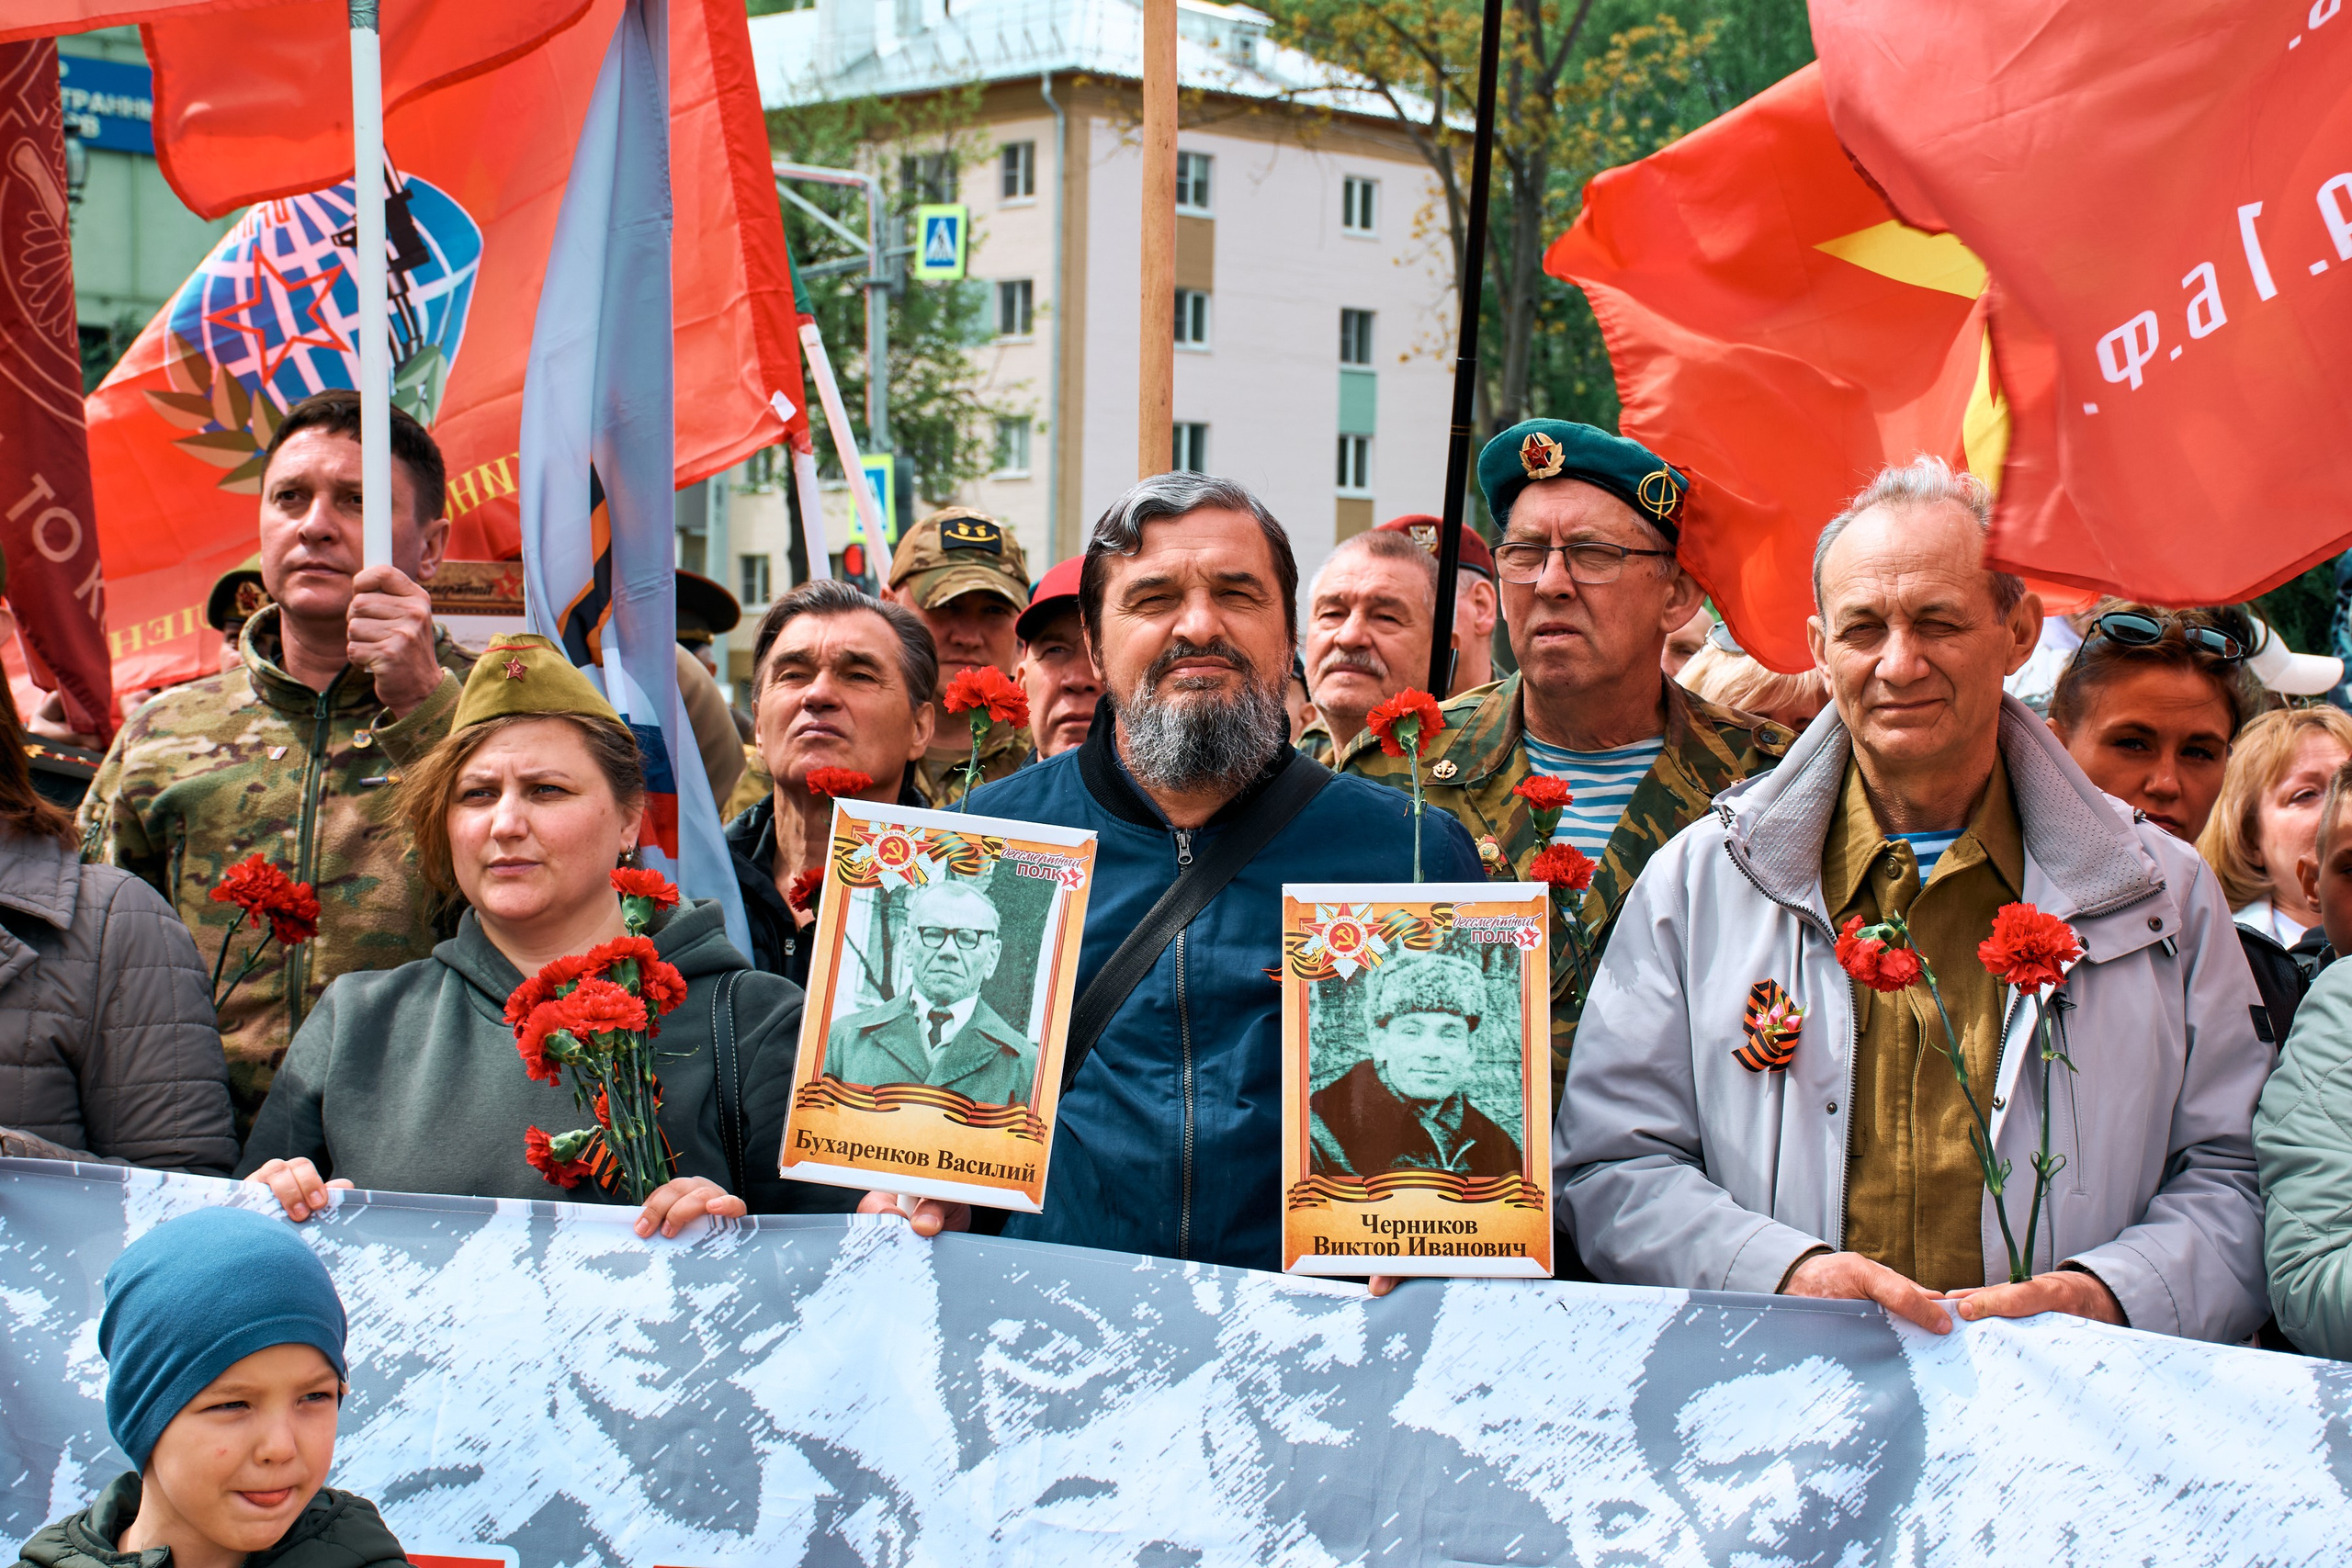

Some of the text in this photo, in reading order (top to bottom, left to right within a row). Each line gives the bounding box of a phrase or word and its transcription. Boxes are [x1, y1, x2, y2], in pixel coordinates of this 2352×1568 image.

[1016, 863, 1062, 881] ПОЛК
[1471, 931, 1518, 942] ПОЛК
[795, 1128, 1036, 1183] Бухаренков Василий
[1360, 1213, 1478, 1240] Черников
[1312, 1235, 1527, 1258] Виктор Иванович
